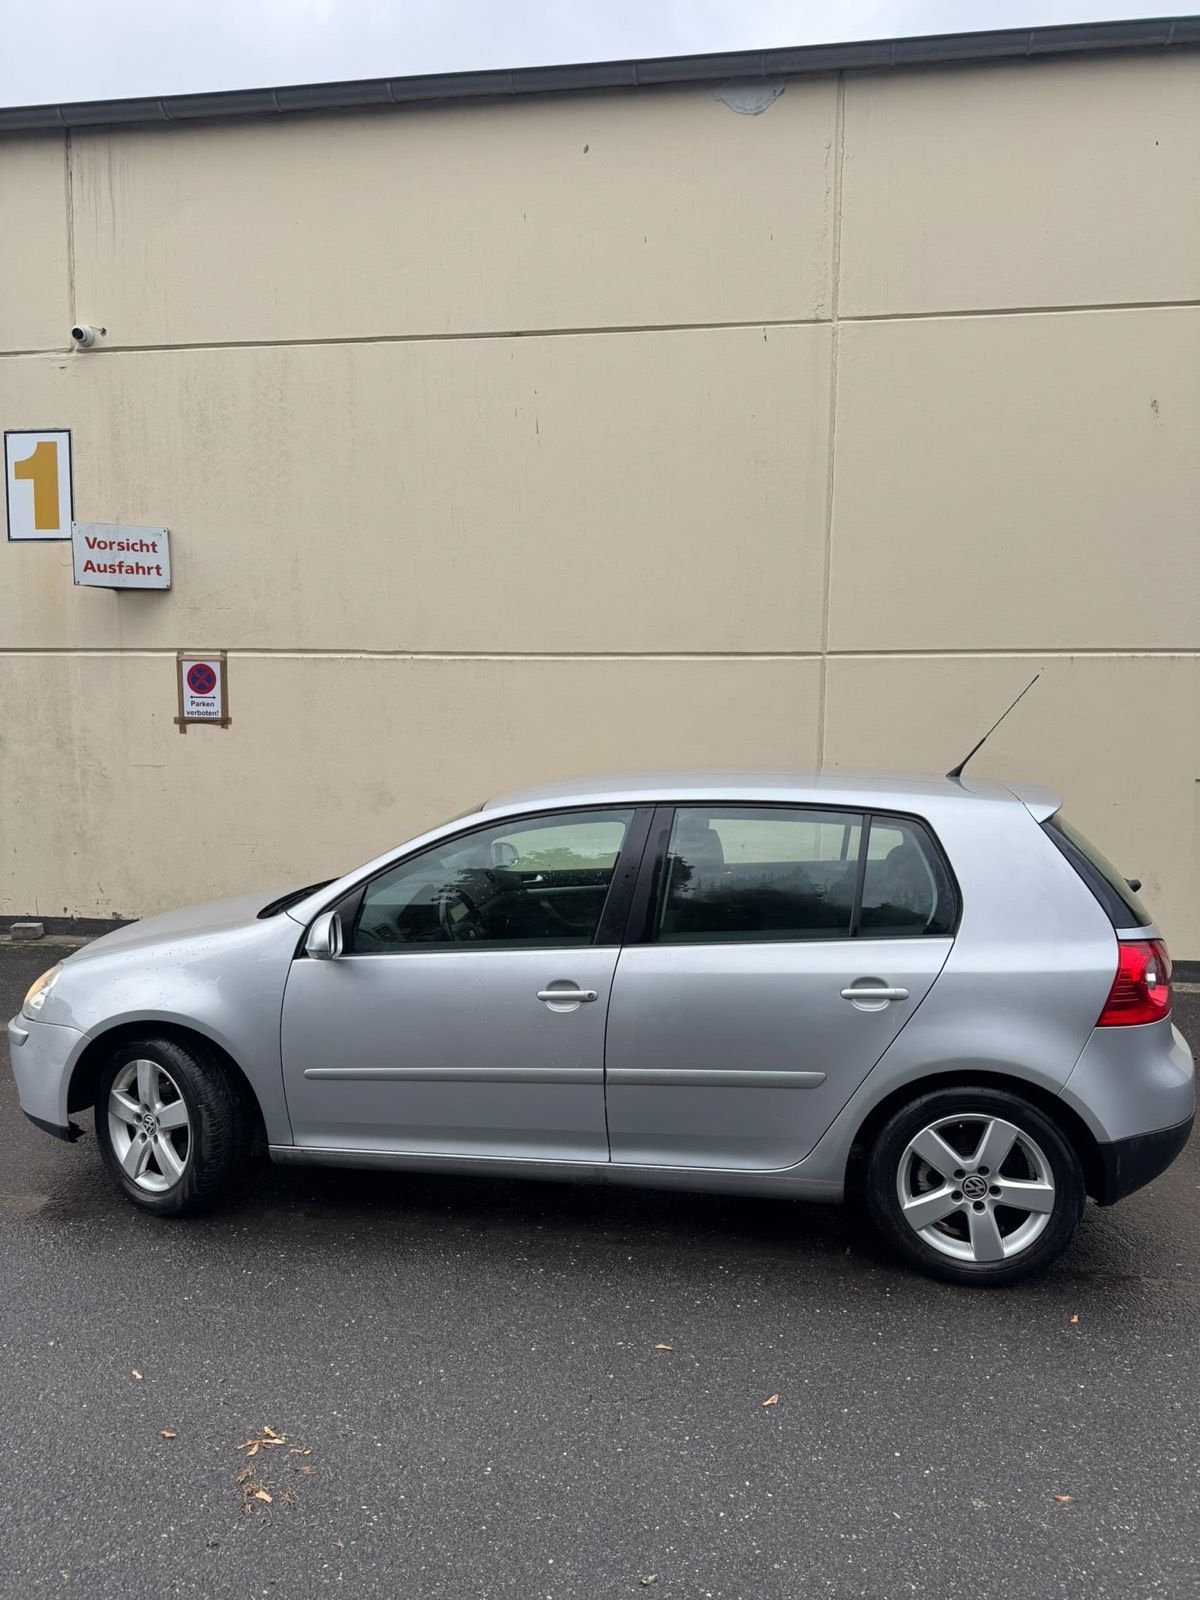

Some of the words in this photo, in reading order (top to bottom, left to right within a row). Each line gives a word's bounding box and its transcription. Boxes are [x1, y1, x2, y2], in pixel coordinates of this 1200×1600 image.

[14, 441, 59, 529] 1
[84, 536, 158, 553] Vorsicht
[83, 559, 162, 576] Ausfahrt
